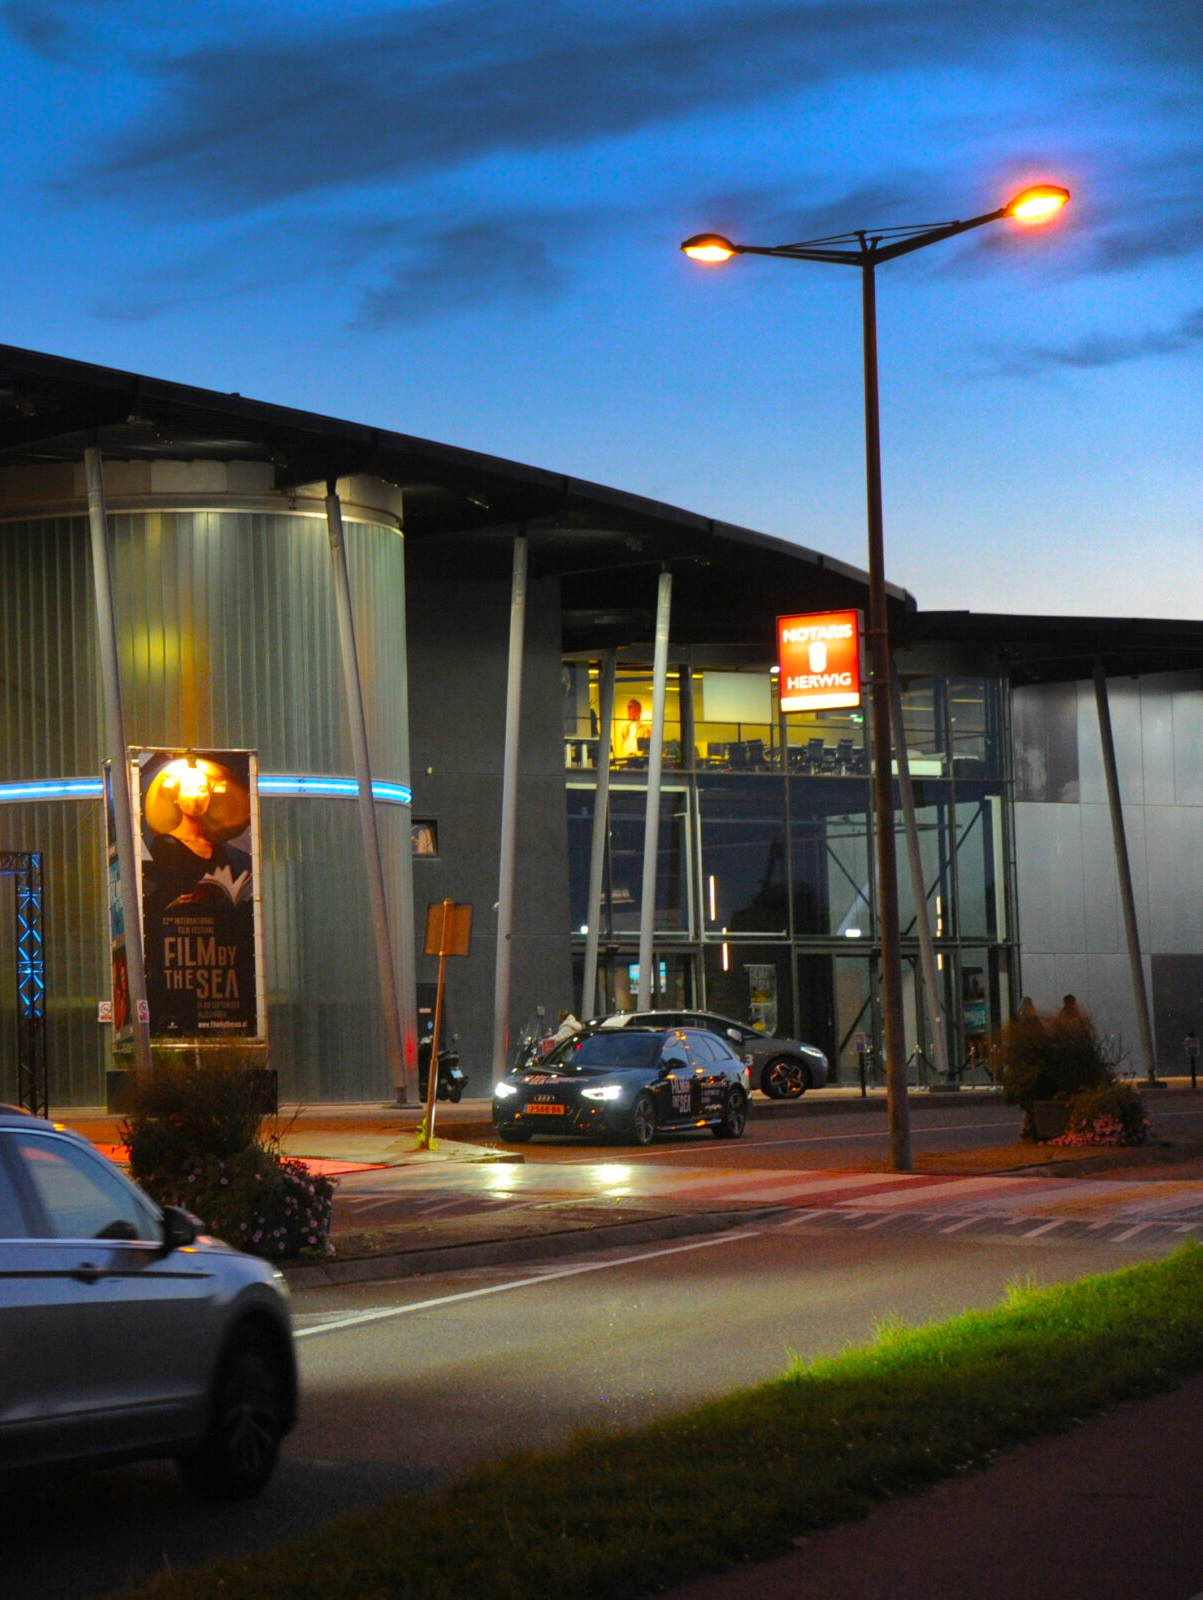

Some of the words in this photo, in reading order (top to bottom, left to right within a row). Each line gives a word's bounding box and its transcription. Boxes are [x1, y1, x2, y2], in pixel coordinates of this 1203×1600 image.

[782, 623, 853, 643] NOTARIS
[787, 672, 852, 690] HERWIG
[164, 936, 217, 967] FILM
[218, 946, 237, 966] BY
[164, 970, 195, 990] THE
[196, 969, 239, 999] SEA
